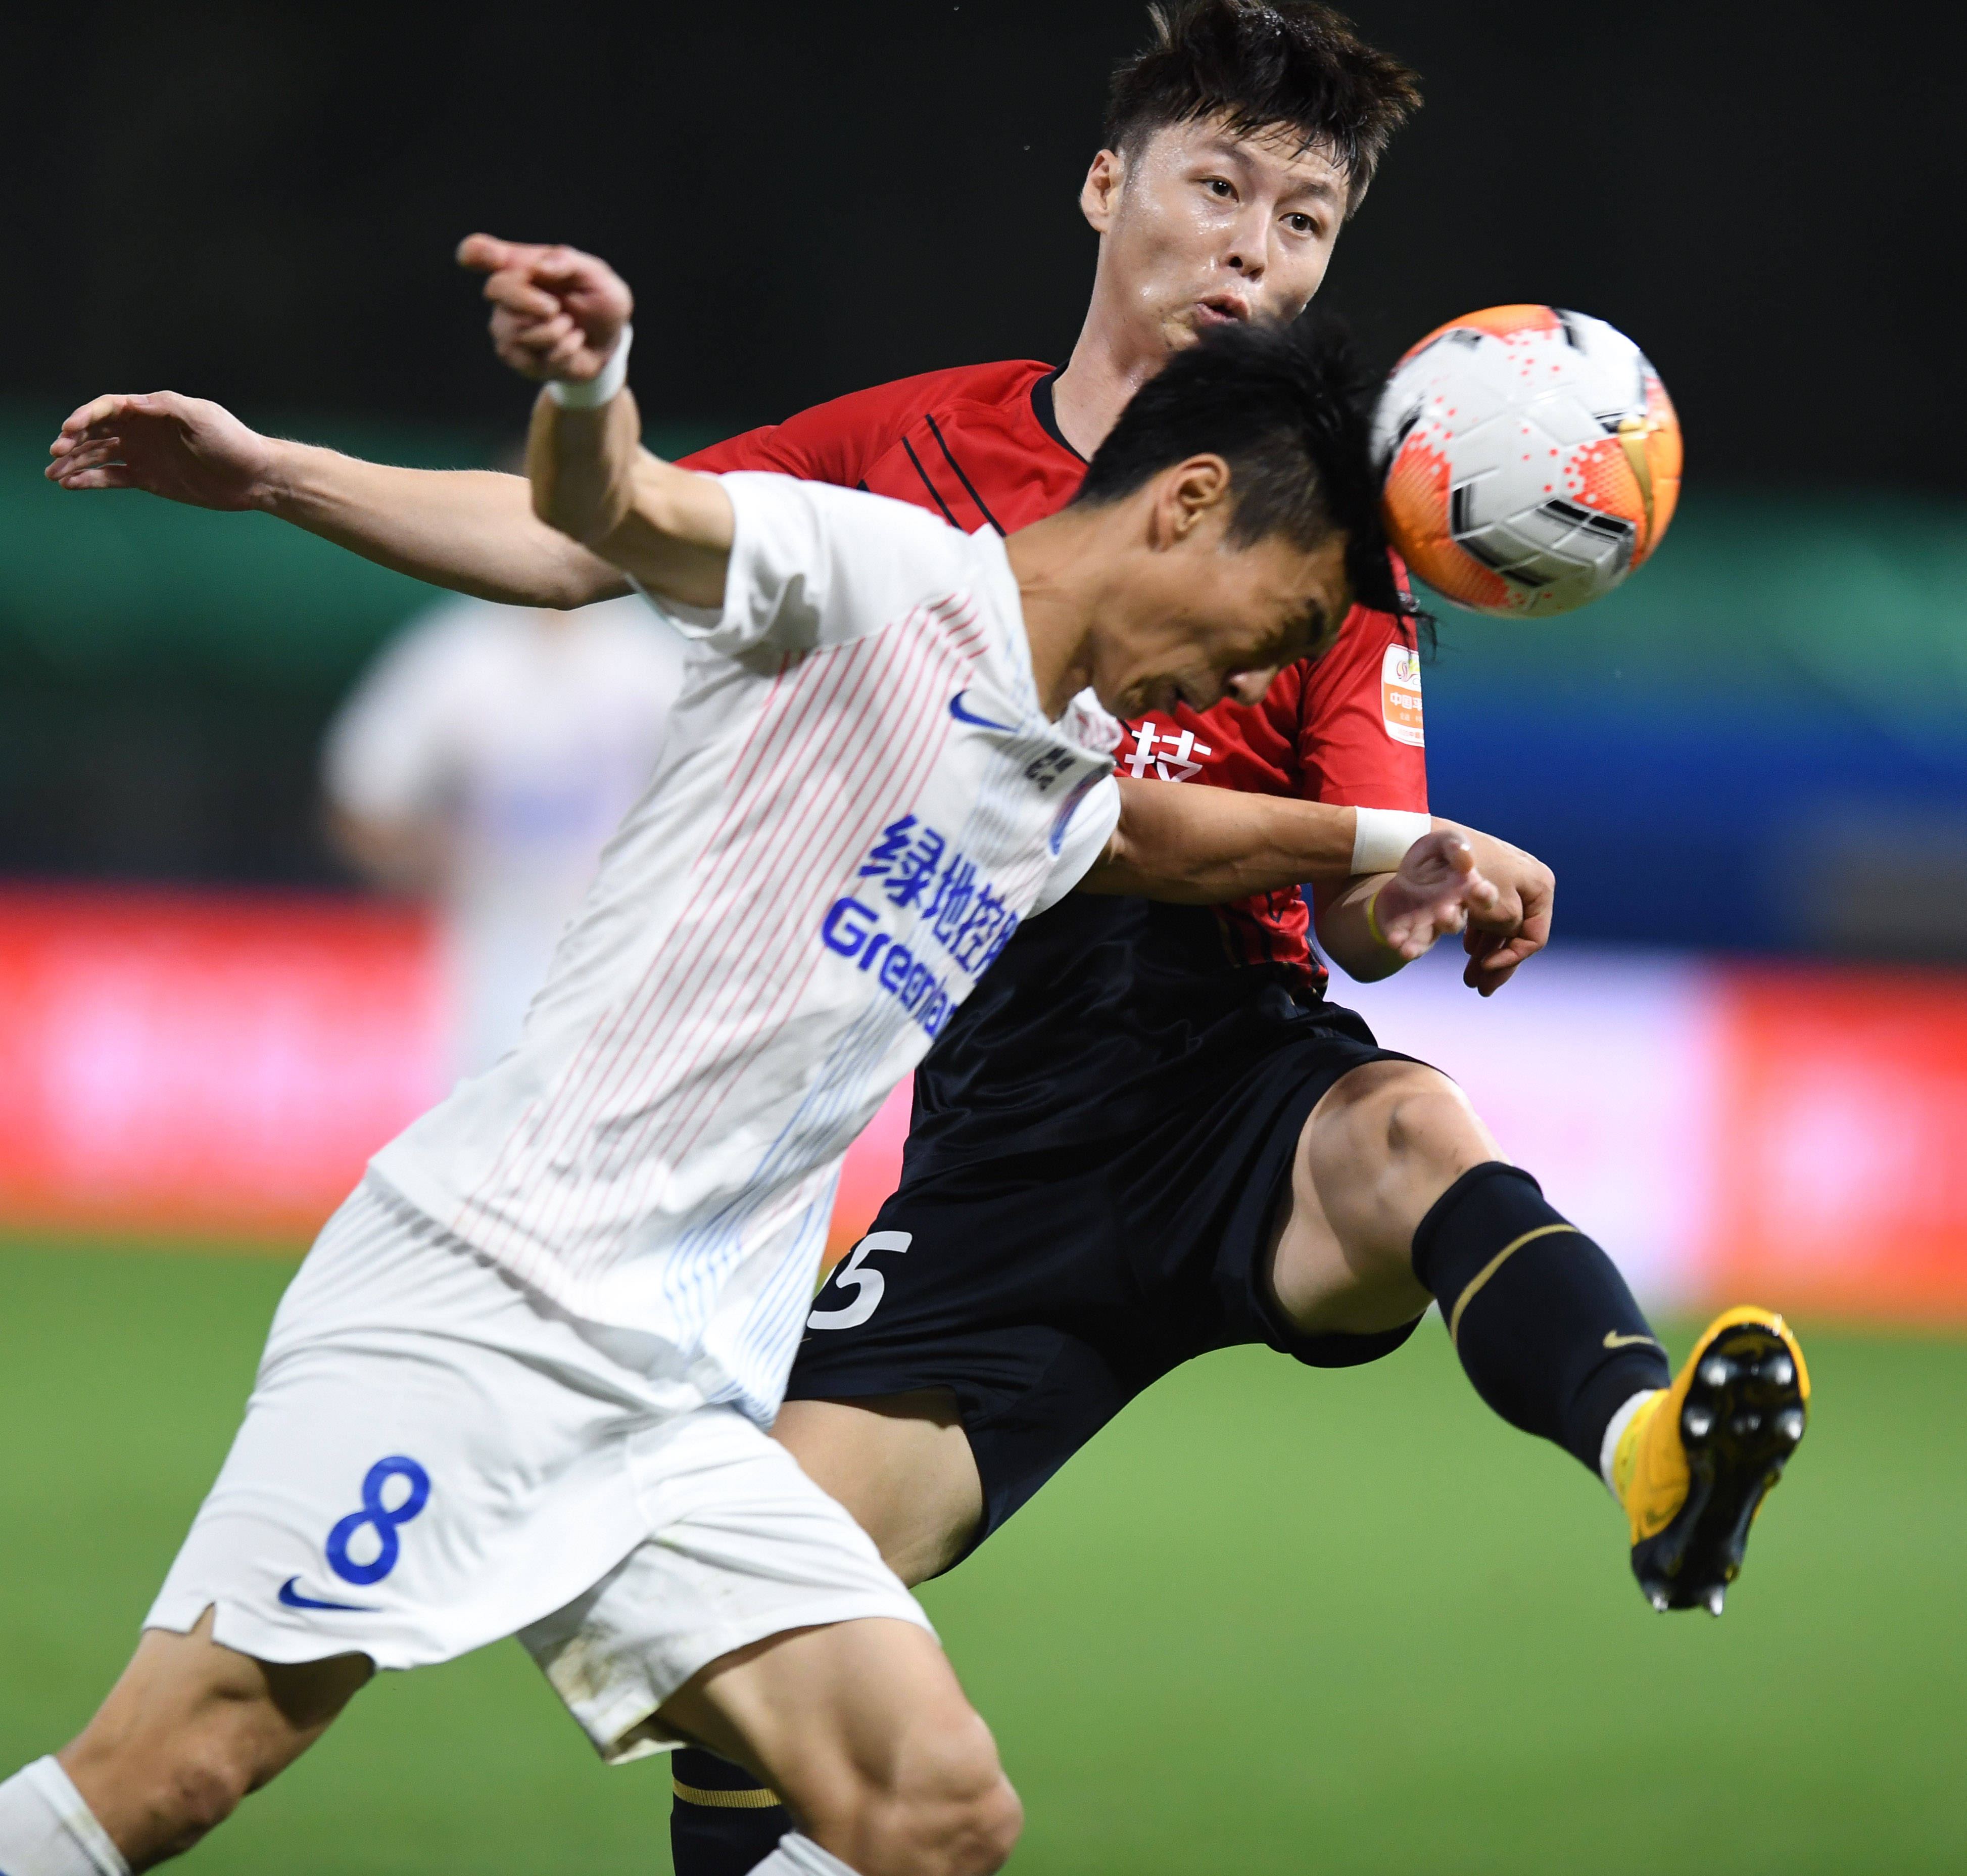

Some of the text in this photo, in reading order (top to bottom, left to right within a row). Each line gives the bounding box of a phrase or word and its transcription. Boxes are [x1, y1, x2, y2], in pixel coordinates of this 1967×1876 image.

[1124, 721, 1212, 782] 技
[806, 1231, 913, 1330] 5
[325, 1456, 430, 1585] 8
